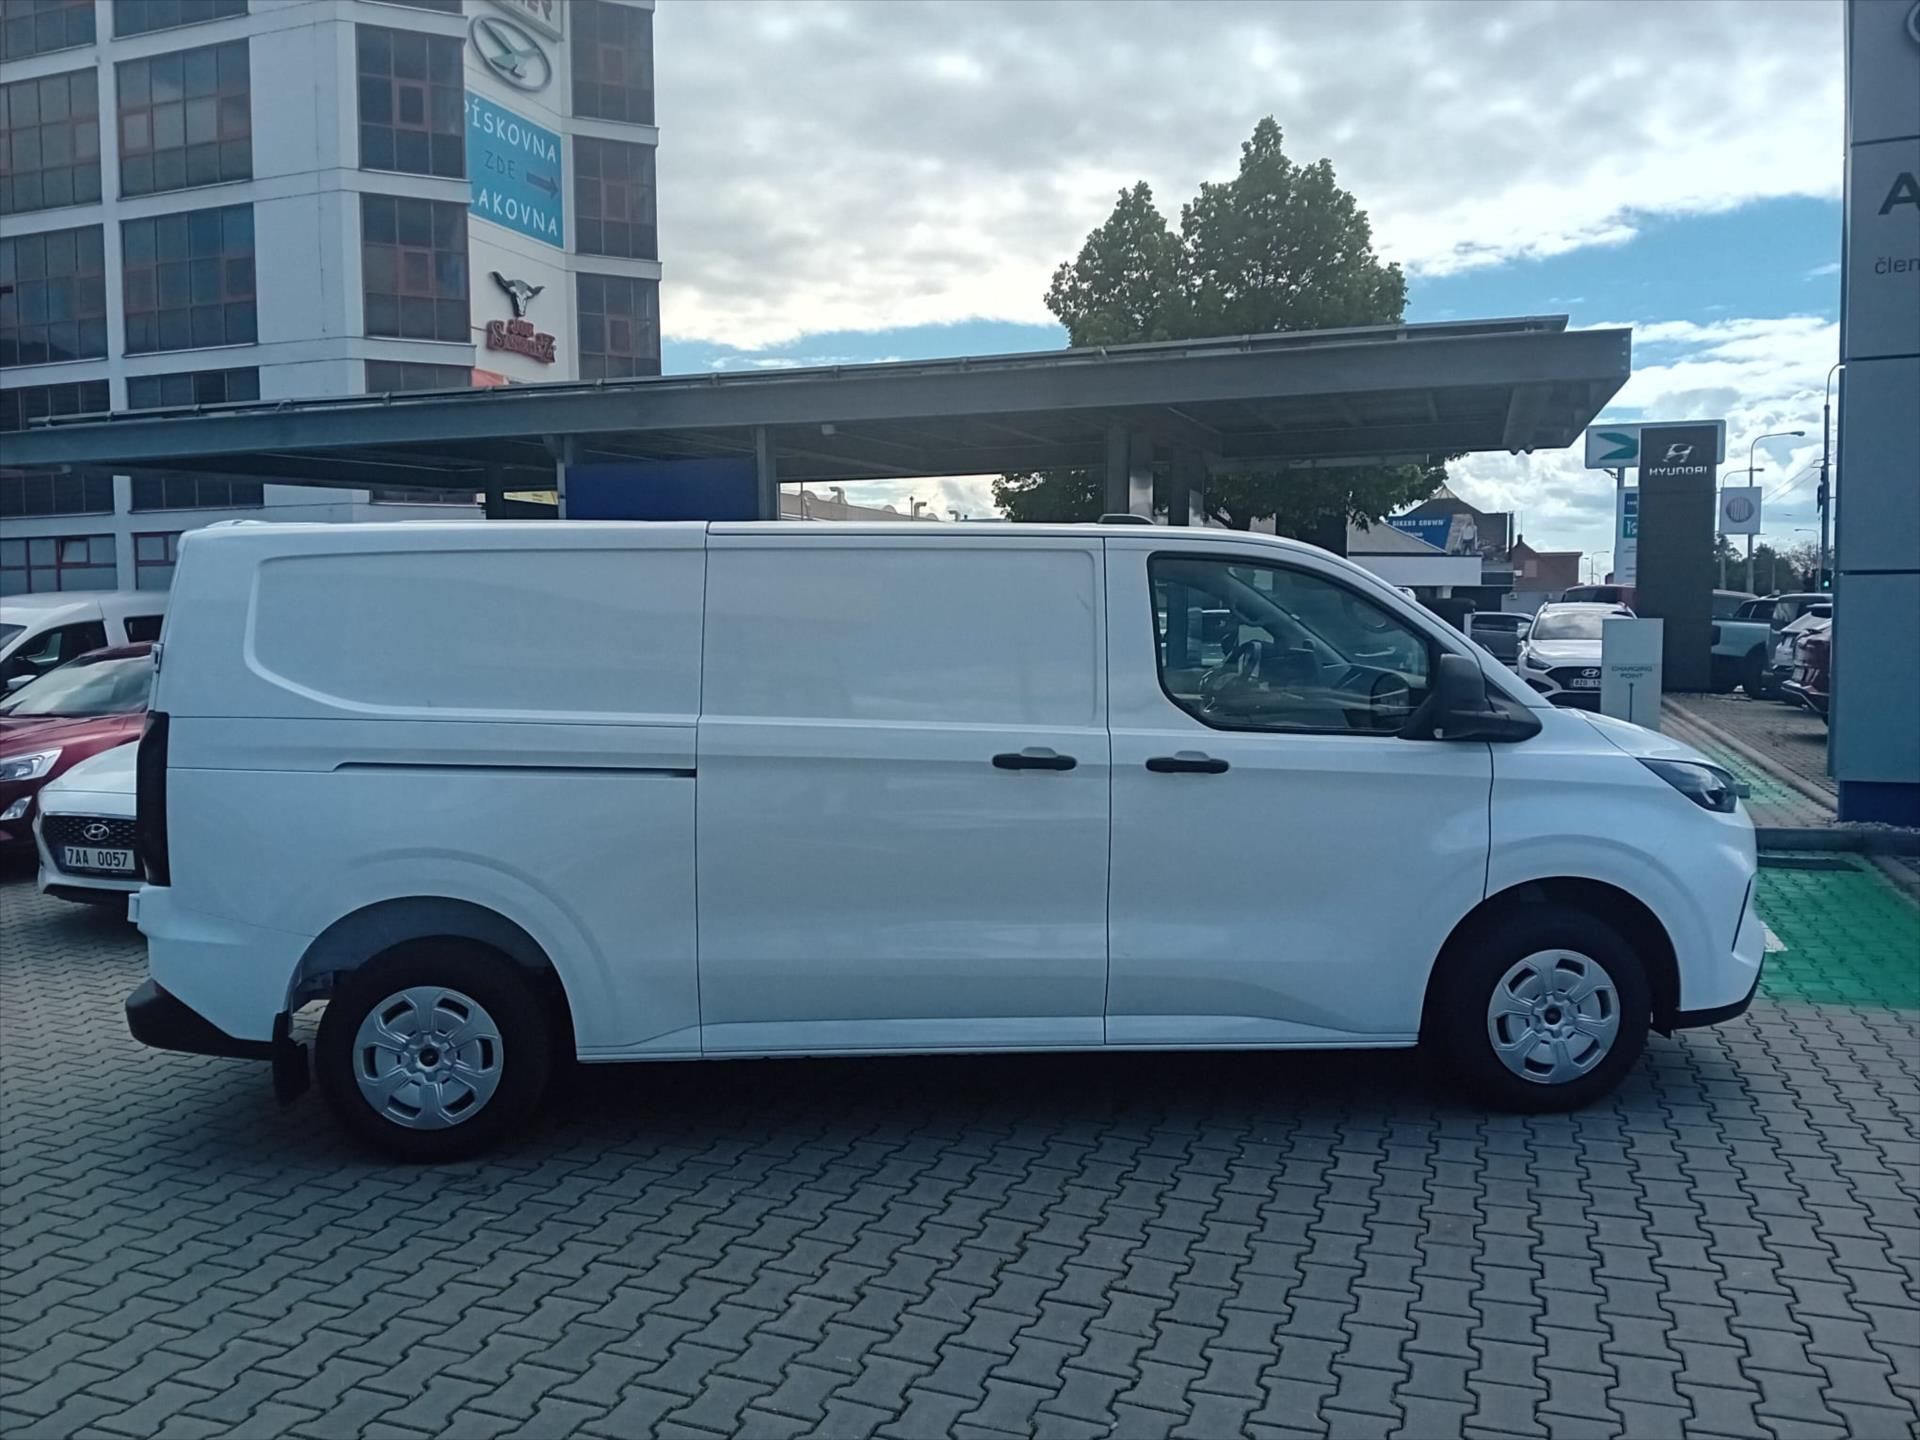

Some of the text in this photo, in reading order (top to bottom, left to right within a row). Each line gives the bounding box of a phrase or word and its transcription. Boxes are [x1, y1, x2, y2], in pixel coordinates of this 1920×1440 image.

[485, 150, 516, 180] ZDE
[471, 188, 558, 236] AKOVNA
[1649, 466, 1708, 476] HYUNDAI
[67, 848, 128, 868] 7AA 0057
